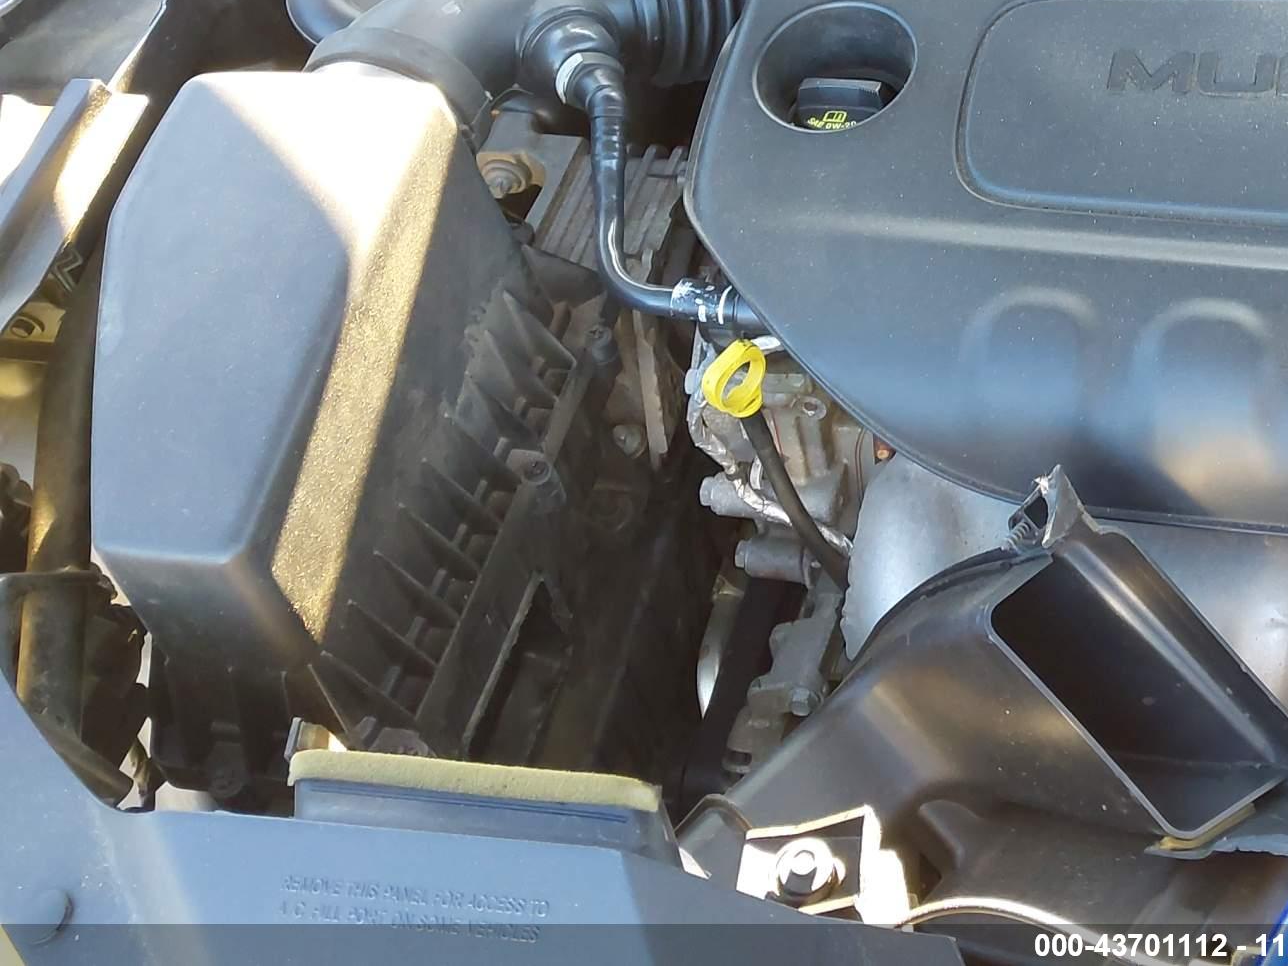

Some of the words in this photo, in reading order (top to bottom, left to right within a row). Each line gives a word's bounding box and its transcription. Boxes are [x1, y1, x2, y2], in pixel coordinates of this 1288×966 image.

[283, 874, 341, 897] REMOVE
[346, 882, 380, 900] THIS
[383, 885, 427, 906] PANEL
[433, 889, 465, 909] FOR
[467, 893, 526, 916] ACCESS
[529, 899, 550, 918] TO
[467, 920, 540, 943] VEHICLES
